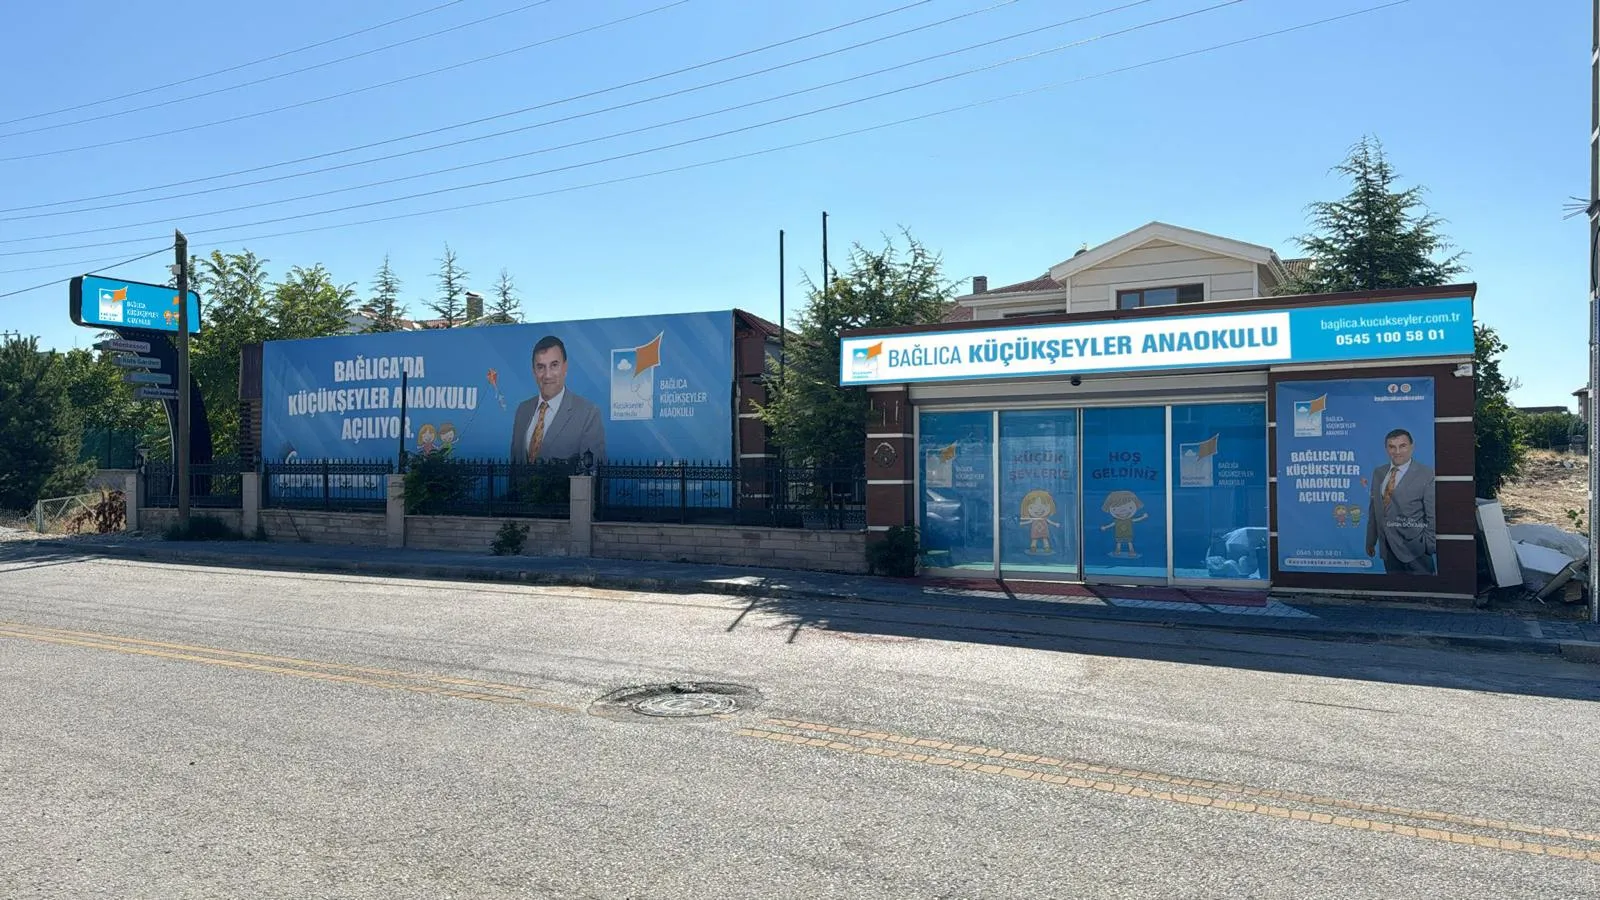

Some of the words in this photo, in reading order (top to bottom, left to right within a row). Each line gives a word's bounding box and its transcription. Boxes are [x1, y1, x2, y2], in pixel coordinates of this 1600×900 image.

[1321, 312, 1460, 331] baglica.kucukseyler.com.tr
[1336, 333, 1370, 346] 0545
[1376, 331, 1401, 344] 100
[1406, 330, 1424, 343] 58
[1429, 329, 1445, 341] 01
[888, 343, 962, 368] BAĞLICA
[969, 335, 1132, 367] KÜÇÜKŞEYLER
[1141, 326, 1278, 354] ANAOKULU
[334, 355, 425, 382] BAĞLICA'DA
[660, 378, 688, 390] BAĞLICA
[288, 387, 389, 417] KÜÇÜKŞEYLER
[392, 386, 478, 410] ANAOKULU
[660, 391, 708, 405] KÜÇÜKŞEYLER
[342, 416, 414, 444] AÇILIYOR.
[1109, 451, 1141, 465] HOŞ
[1291, 449, 1355, 462] BAĞLICA'DA
[1286, 463, 1360, 478] KÜÇÜKŞEYLER
[1296, 478, 1351, 489] ANAOKULU
[1299, 491, 1348, 504] AÇILIYOR.
